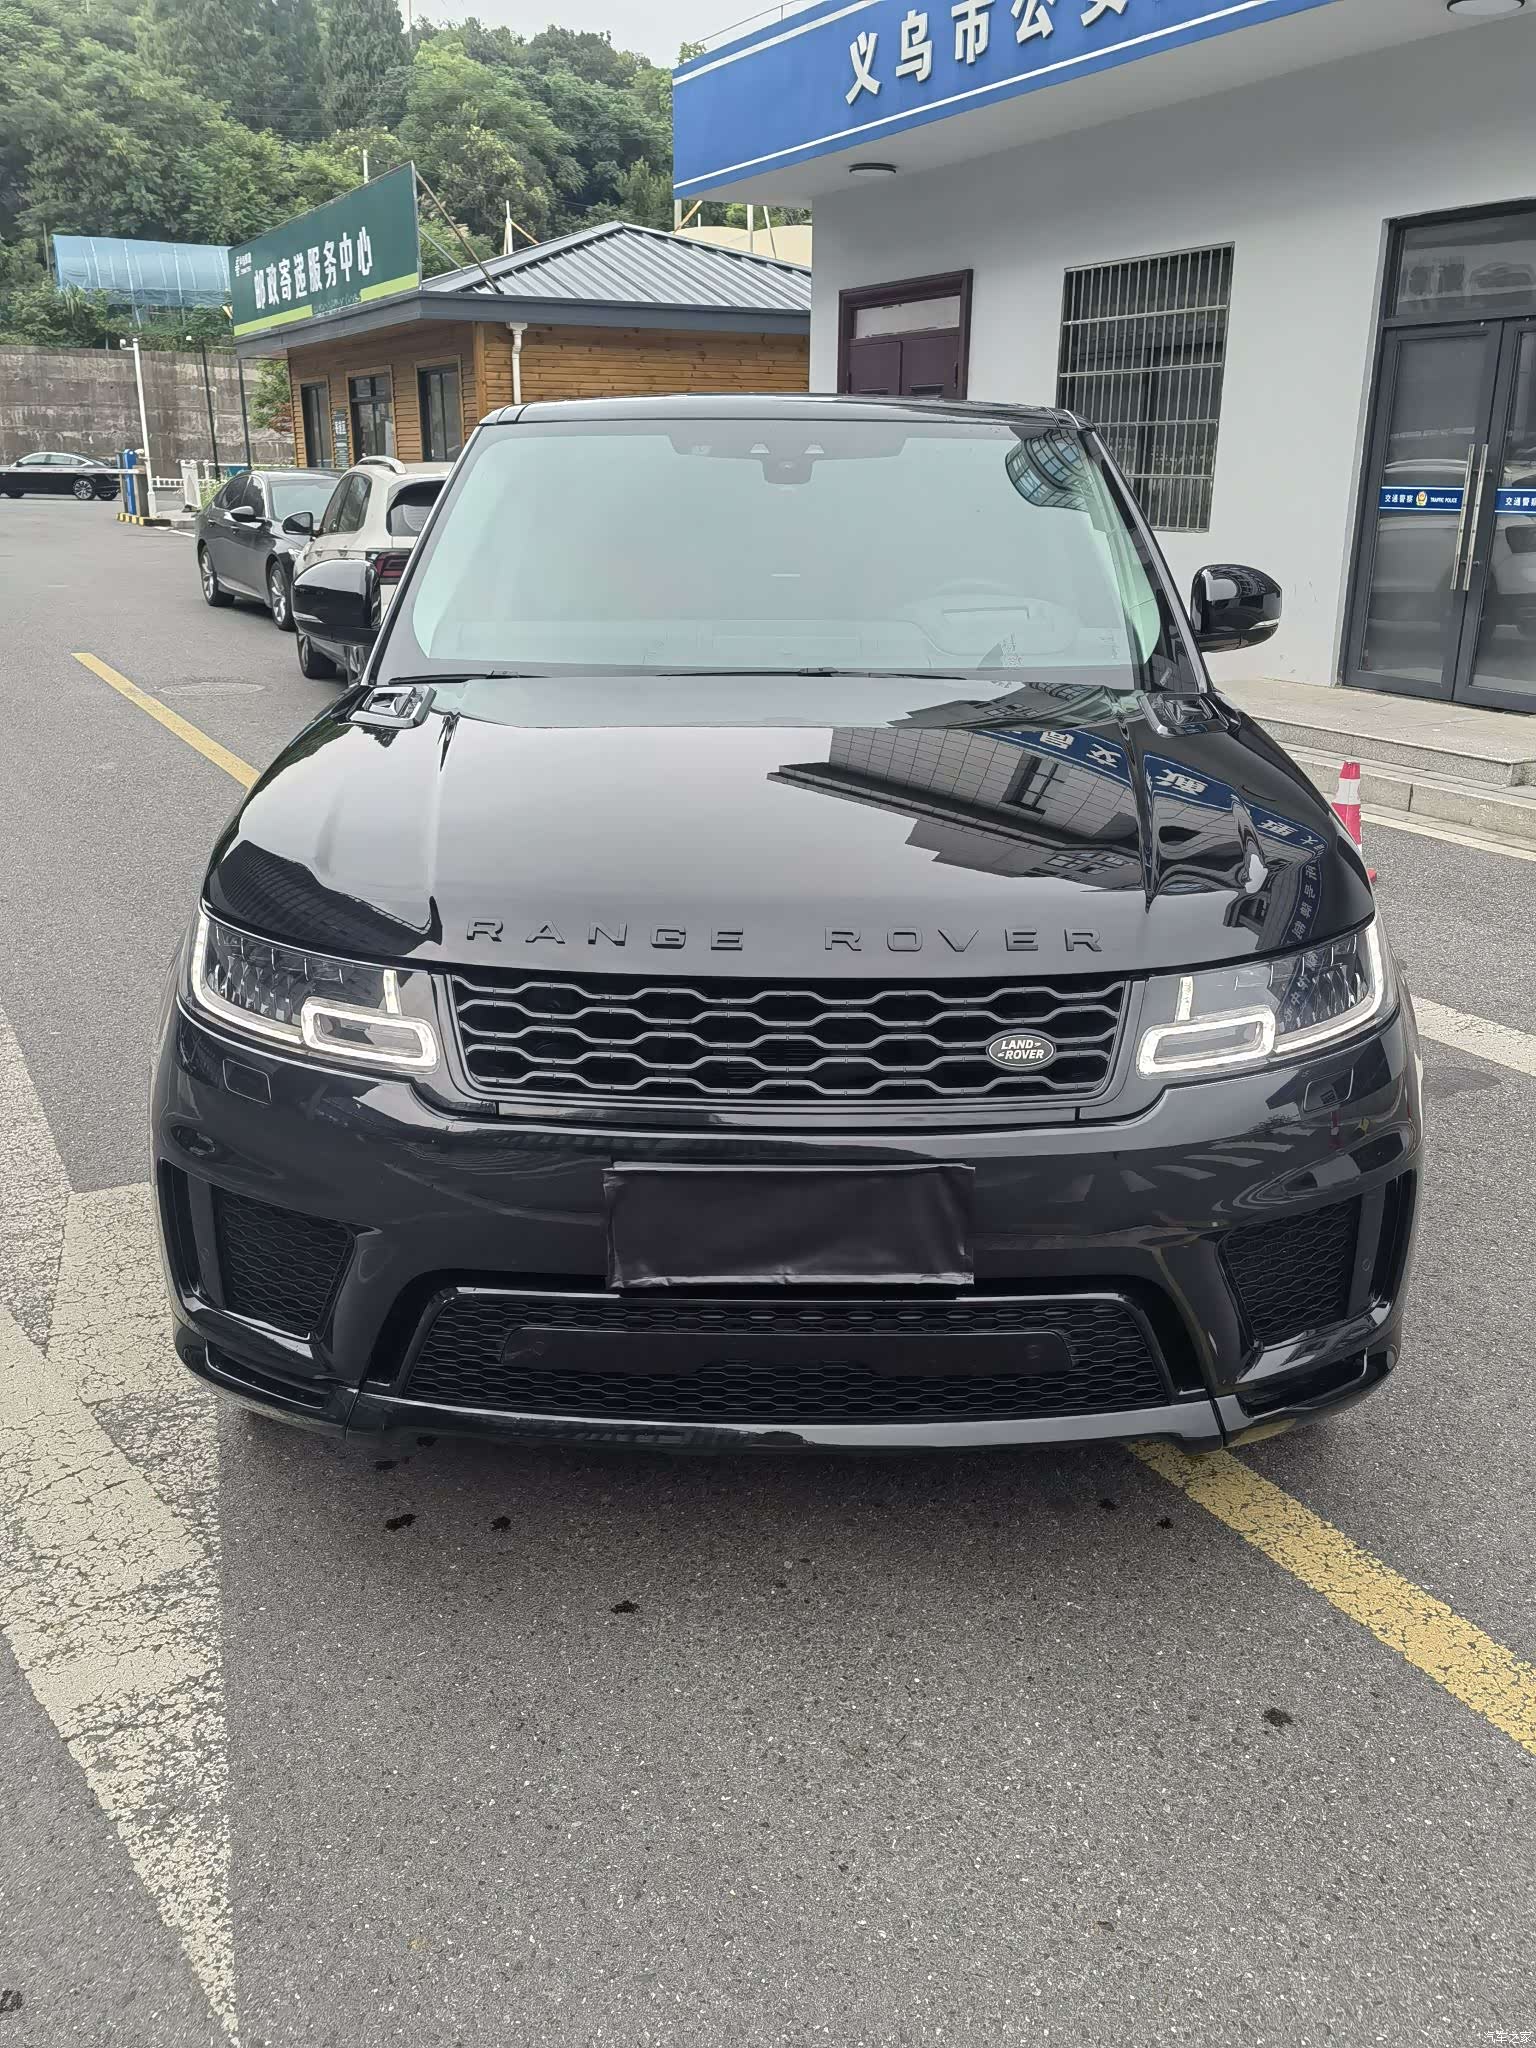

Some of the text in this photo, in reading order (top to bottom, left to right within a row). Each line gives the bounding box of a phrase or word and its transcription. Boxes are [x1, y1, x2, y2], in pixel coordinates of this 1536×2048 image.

[253, 226, 374, 310] 邮政寄递服务中心
[1384, 493, 1413, 504] 交通警察
[466, 916, 1103, 952] RANGE ROVER
[1000, 1039, 1034, 1050] LAND
[1004, 1049, 1045, 1060] ROVER
